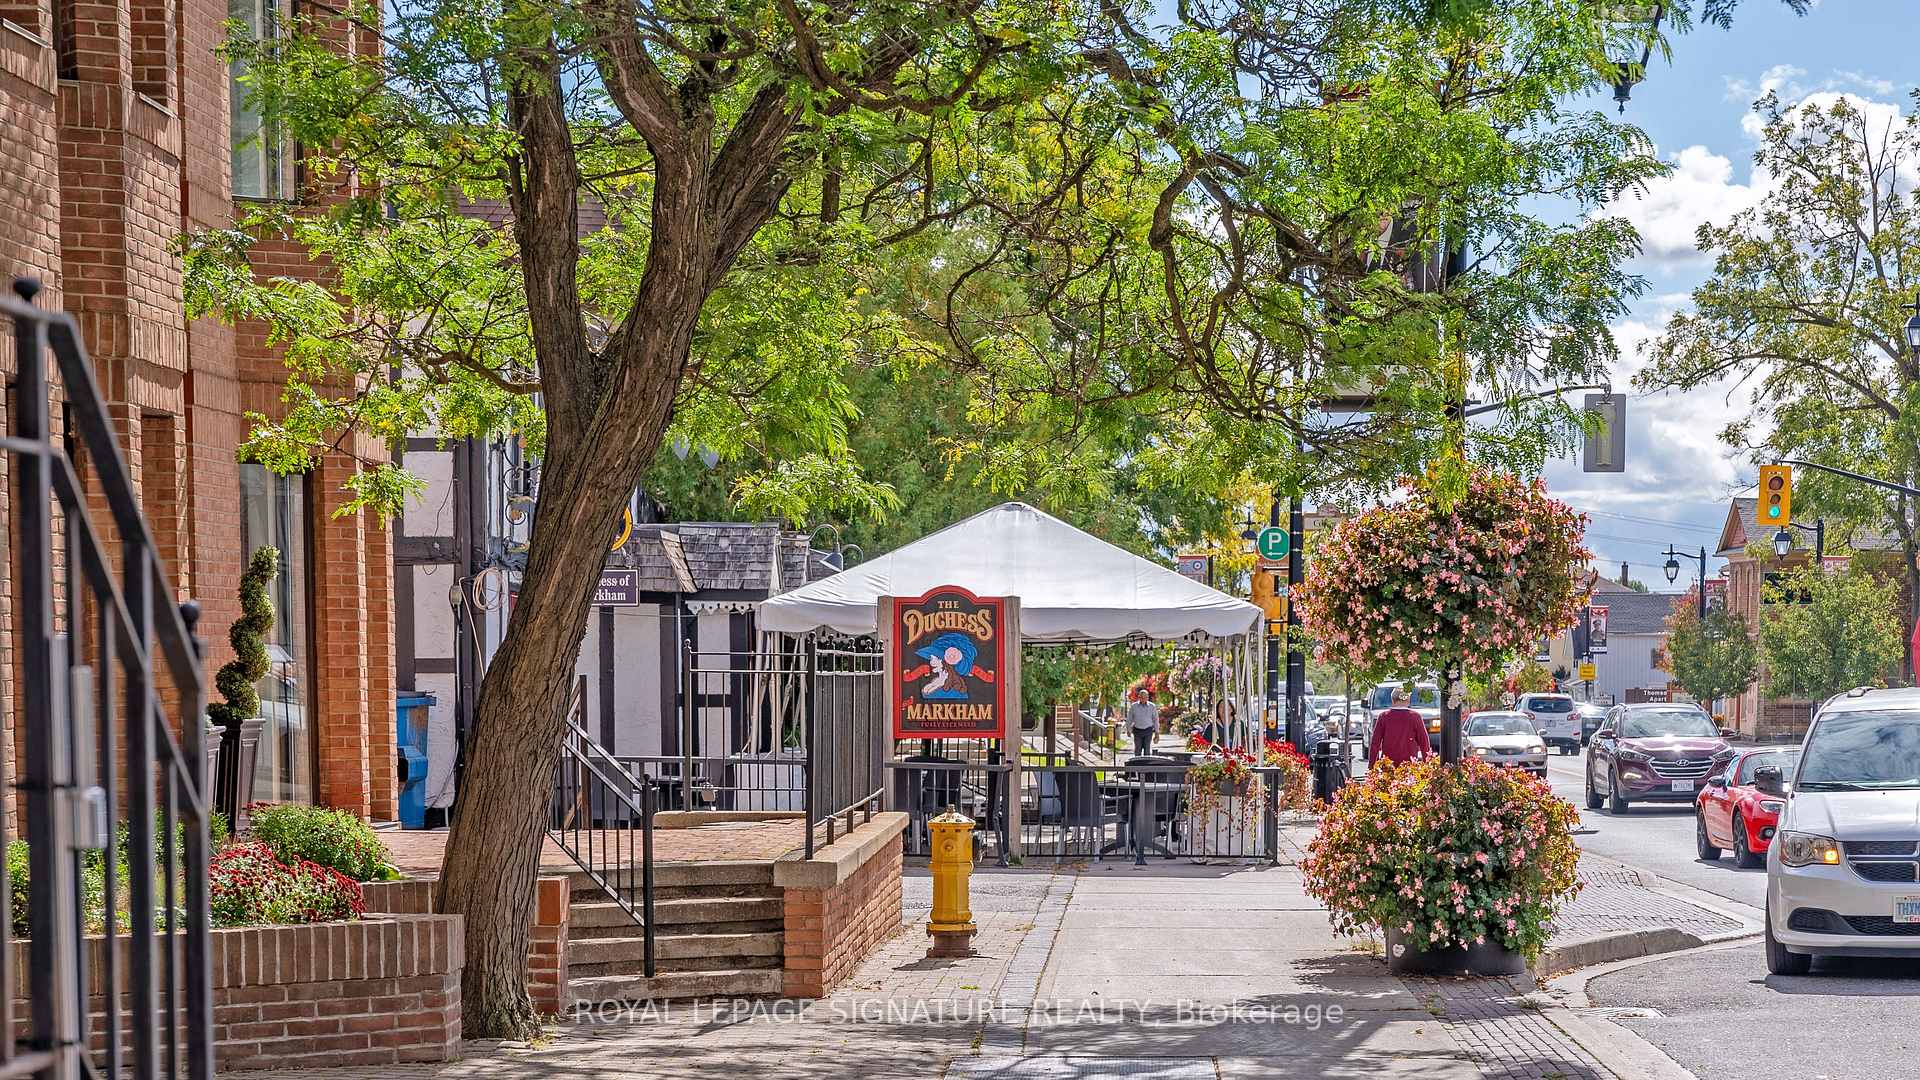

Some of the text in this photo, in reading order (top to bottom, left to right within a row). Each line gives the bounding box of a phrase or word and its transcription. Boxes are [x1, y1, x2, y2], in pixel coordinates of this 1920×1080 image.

[1268, 532, 1282, 550] P
[619, 574, 630, 586] of
[937, 600, 960, 609] THE
[903, 609, 993, 645] DUCHESS
[907, 703, 993, 720] MARKHAM
